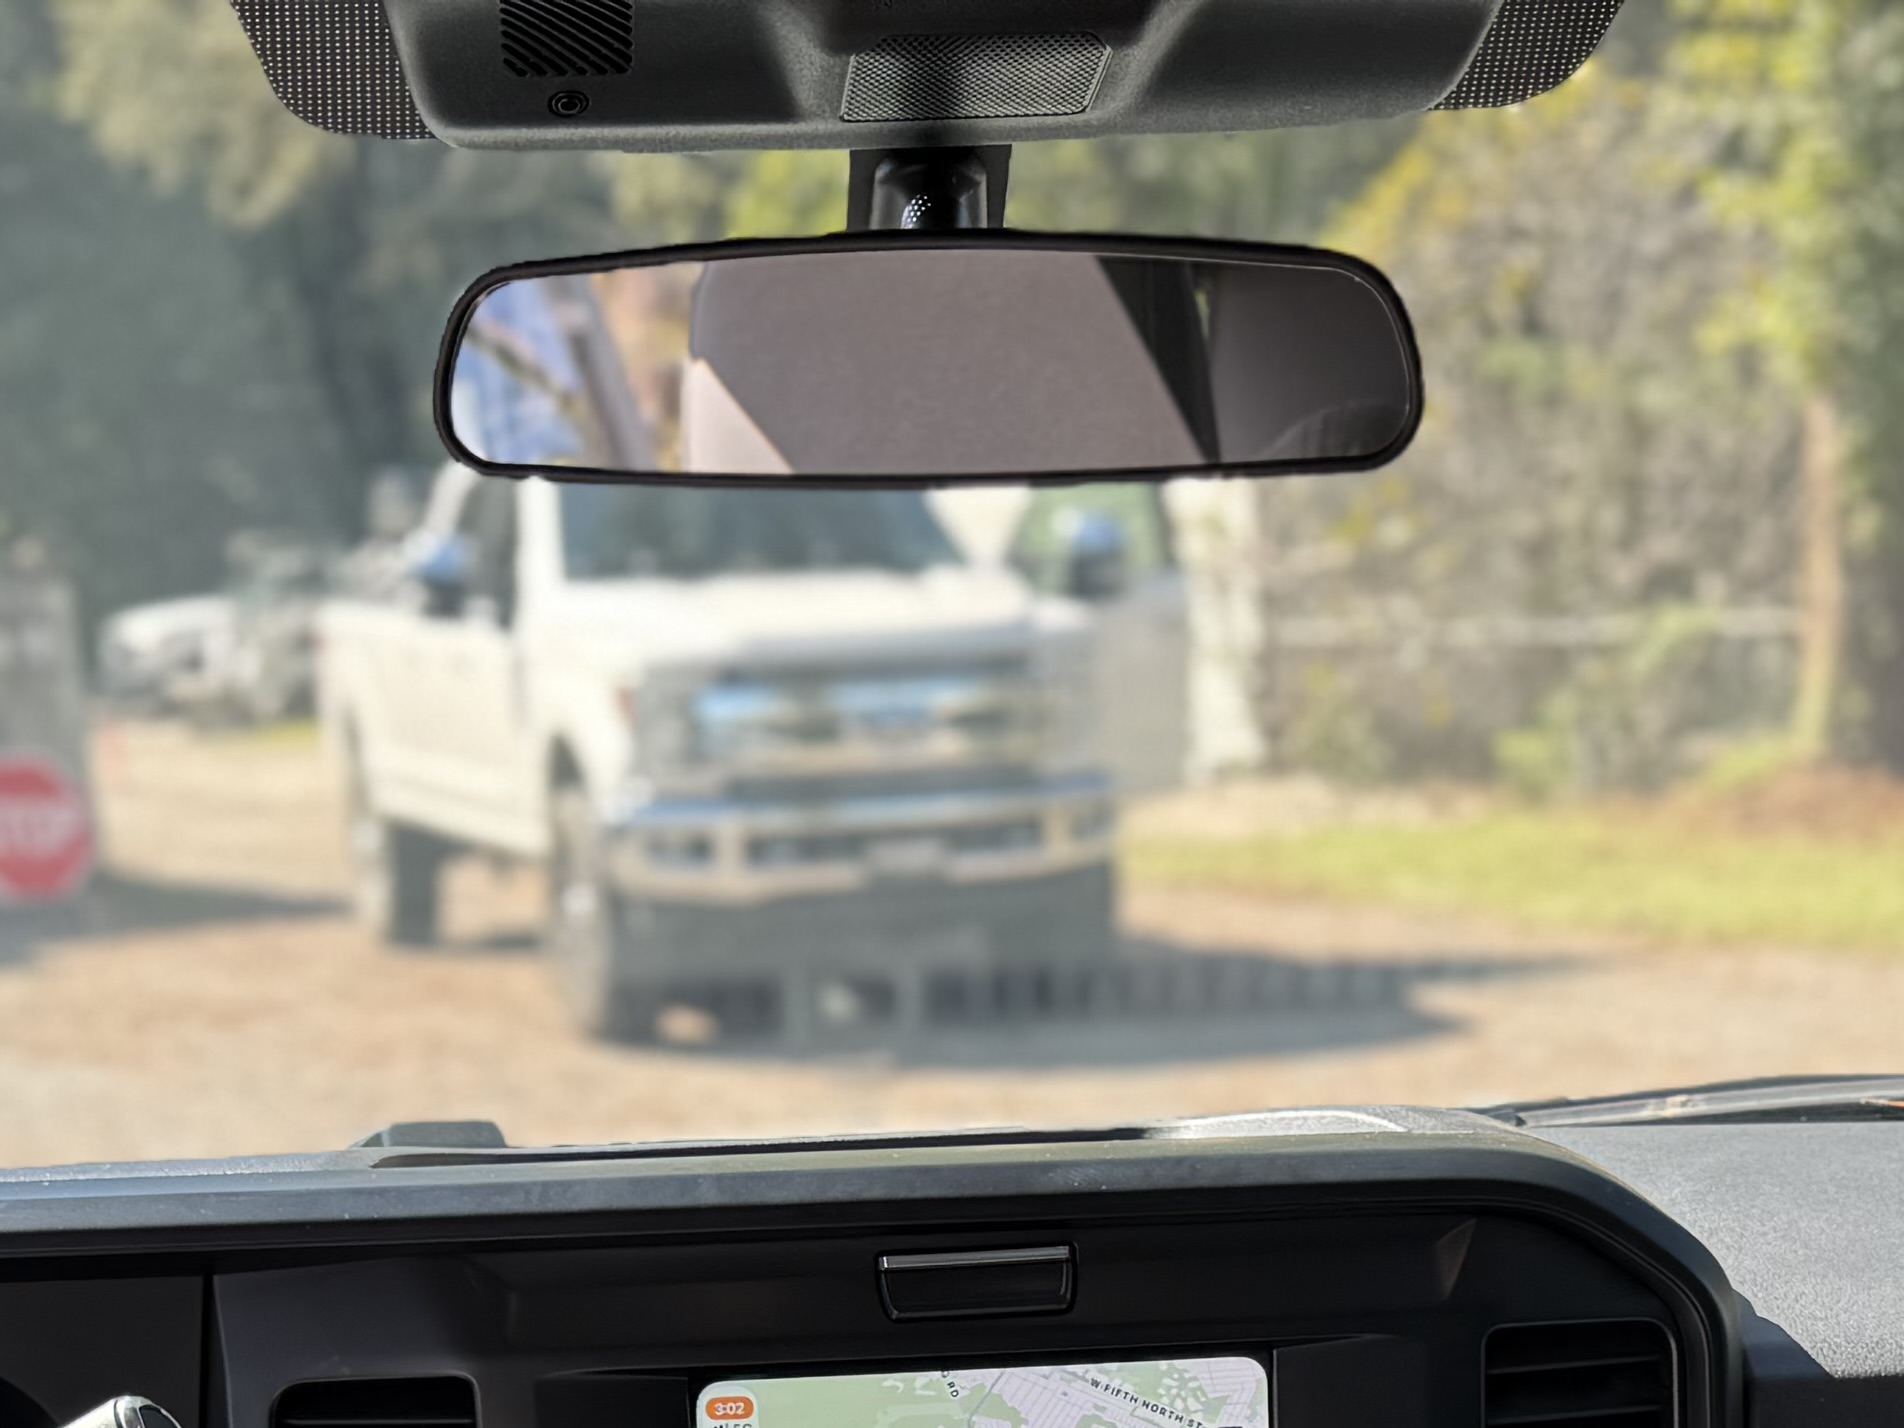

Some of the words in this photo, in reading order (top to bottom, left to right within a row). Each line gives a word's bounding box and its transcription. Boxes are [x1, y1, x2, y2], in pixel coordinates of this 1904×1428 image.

[714, 1402, 745, 1416] 3:02
[1102, 1383, 1139, 1404] FIFTH
[1142, 1399, 1185, 1424] NORTH
